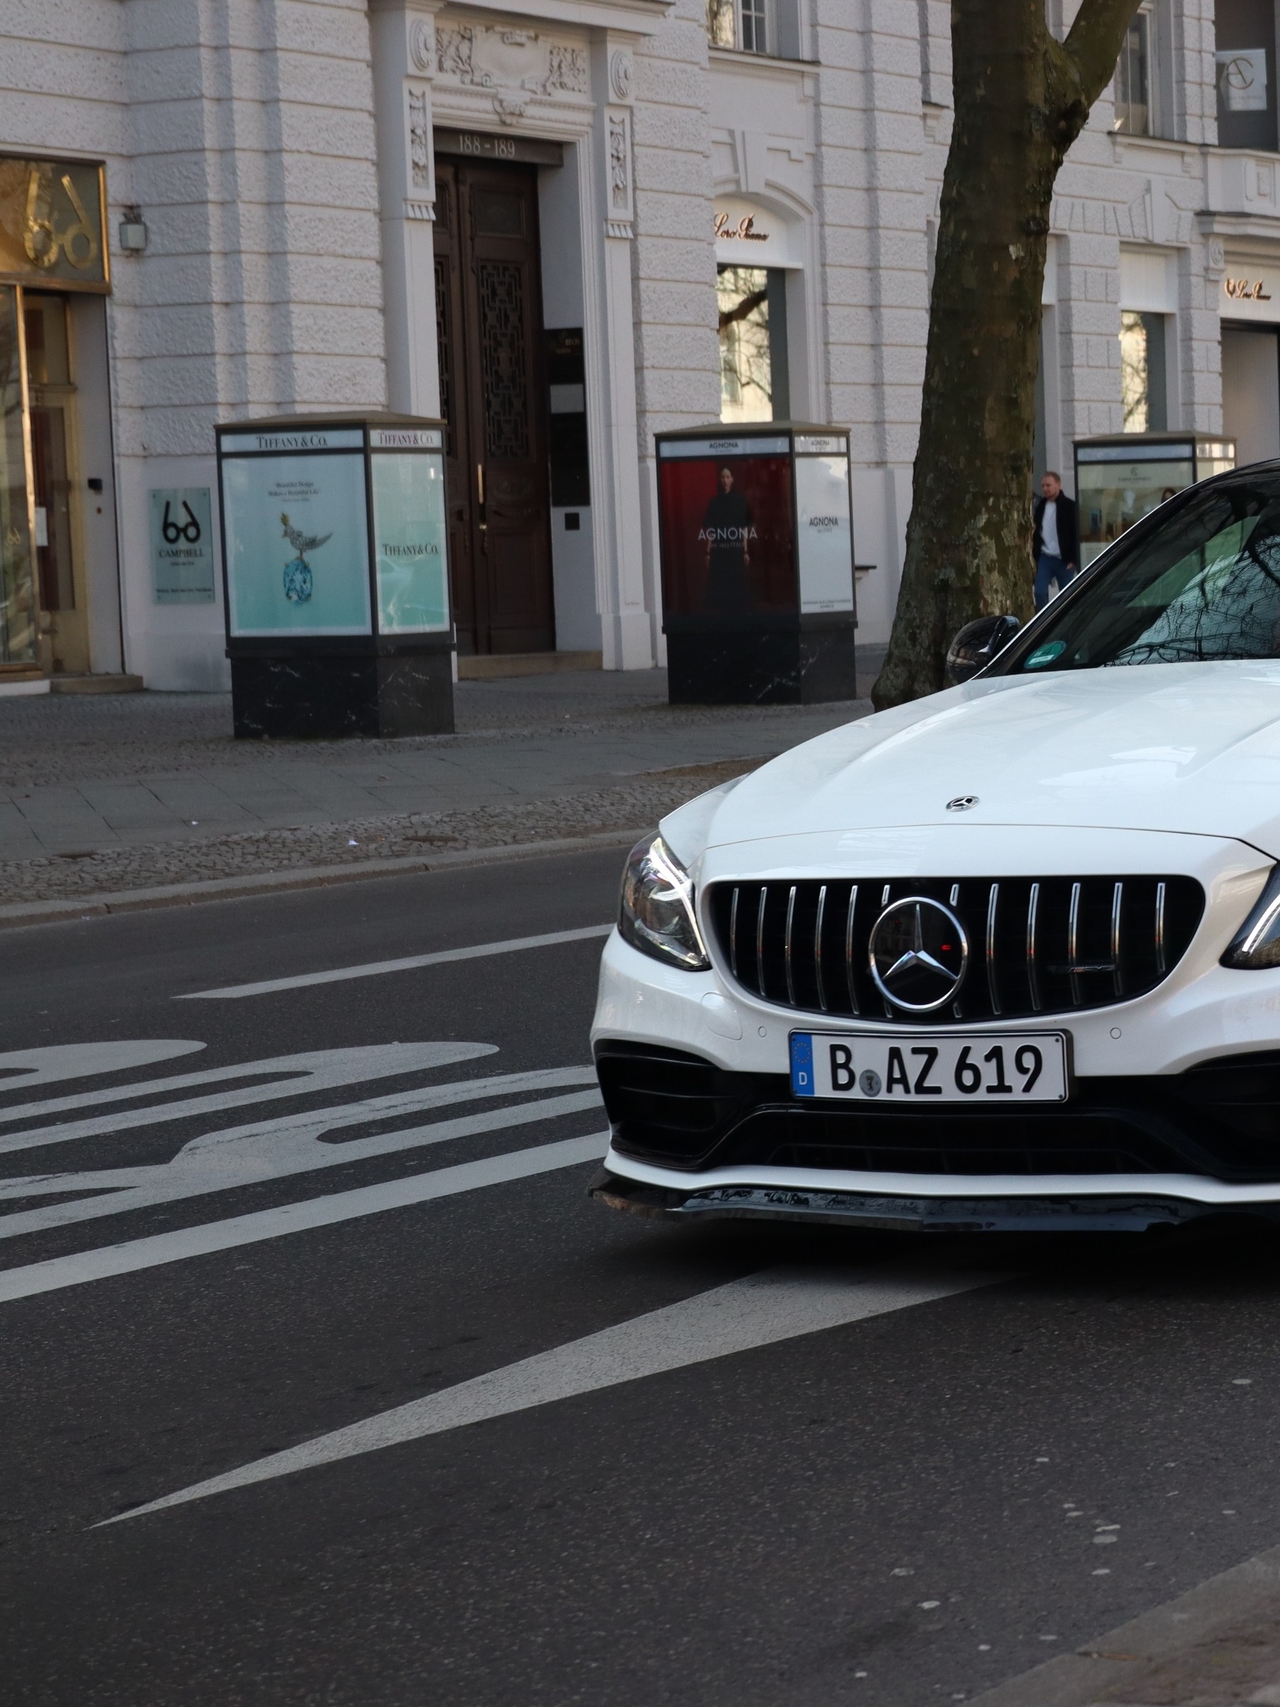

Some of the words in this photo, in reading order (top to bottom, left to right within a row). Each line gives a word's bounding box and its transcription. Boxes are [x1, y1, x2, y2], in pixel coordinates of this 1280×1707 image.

[809, 516, 839, 527] AGNONA
[698, 527, 758, 541] AGNONA
[159, 547, 204, 559] CAMPBELL
[829, 1043, 856, 1092] B
[886, 1046, 943, 1095] AZ
[954, 1044, 1043, 1095] 619
[799, 1072, 807, 1085] D
